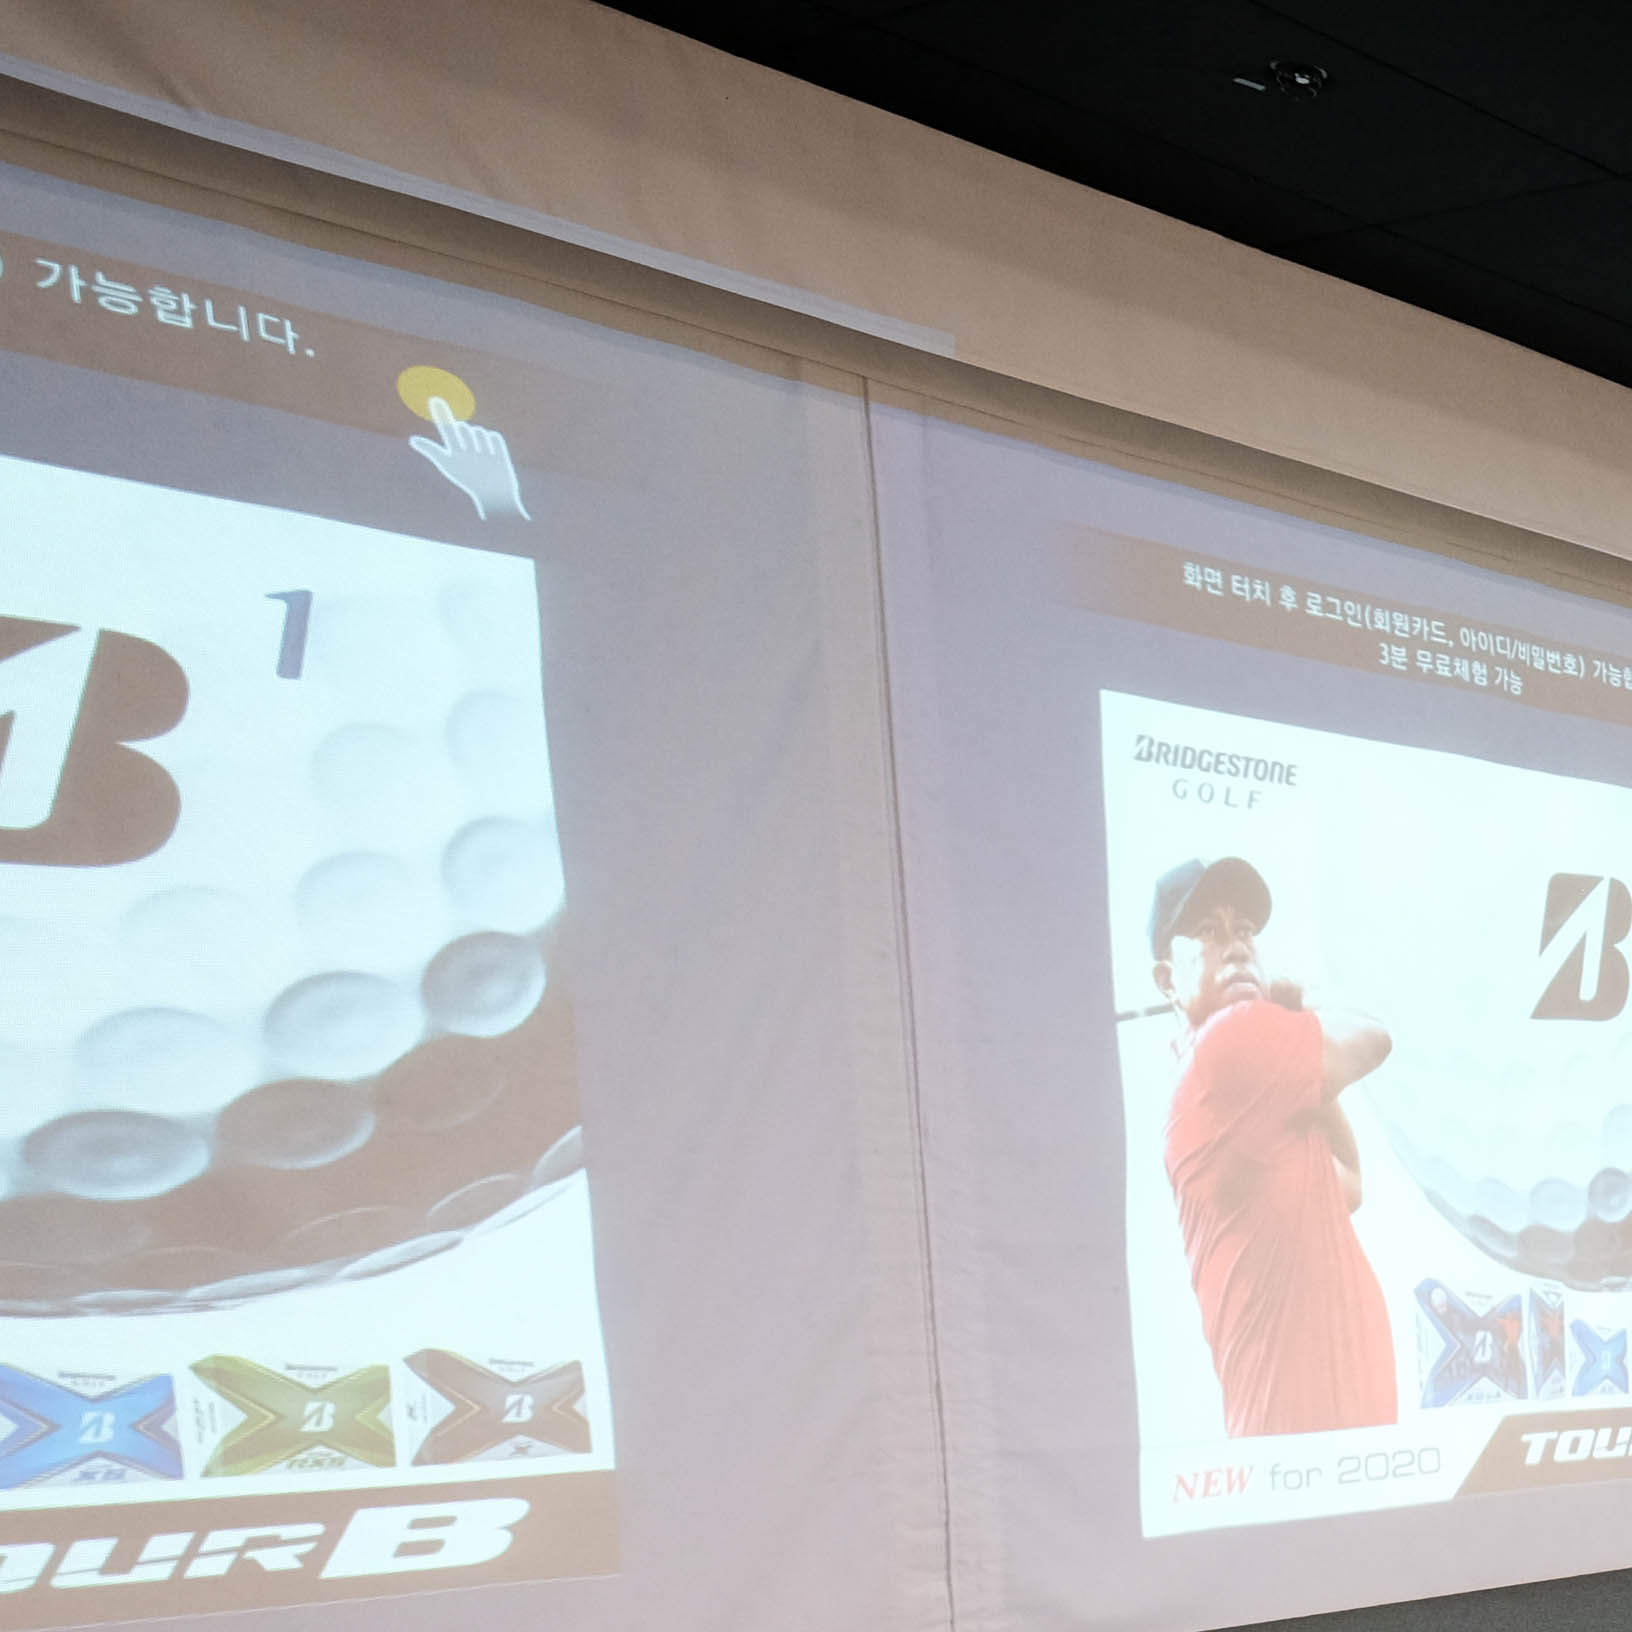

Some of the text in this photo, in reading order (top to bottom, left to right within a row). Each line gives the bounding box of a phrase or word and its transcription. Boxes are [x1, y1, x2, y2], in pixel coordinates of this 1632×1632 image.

[36, 258, 316, 357] 가능합니다.
[1183, 561, 1225, 597] 화면
[1231, 574, 1272, 607] 터치
[1279, 583, 1298, 611] 후
[264, 589, 314, 681] 1
[1378, 643, 1523, 696] 3분 무료체험 가능
[1133, 733, 1298, 788] BRIDGESTONE
[1172, 778, 1262, 810] GOLF
[1173, 1446, 1441, 1503] NEW for 2020
